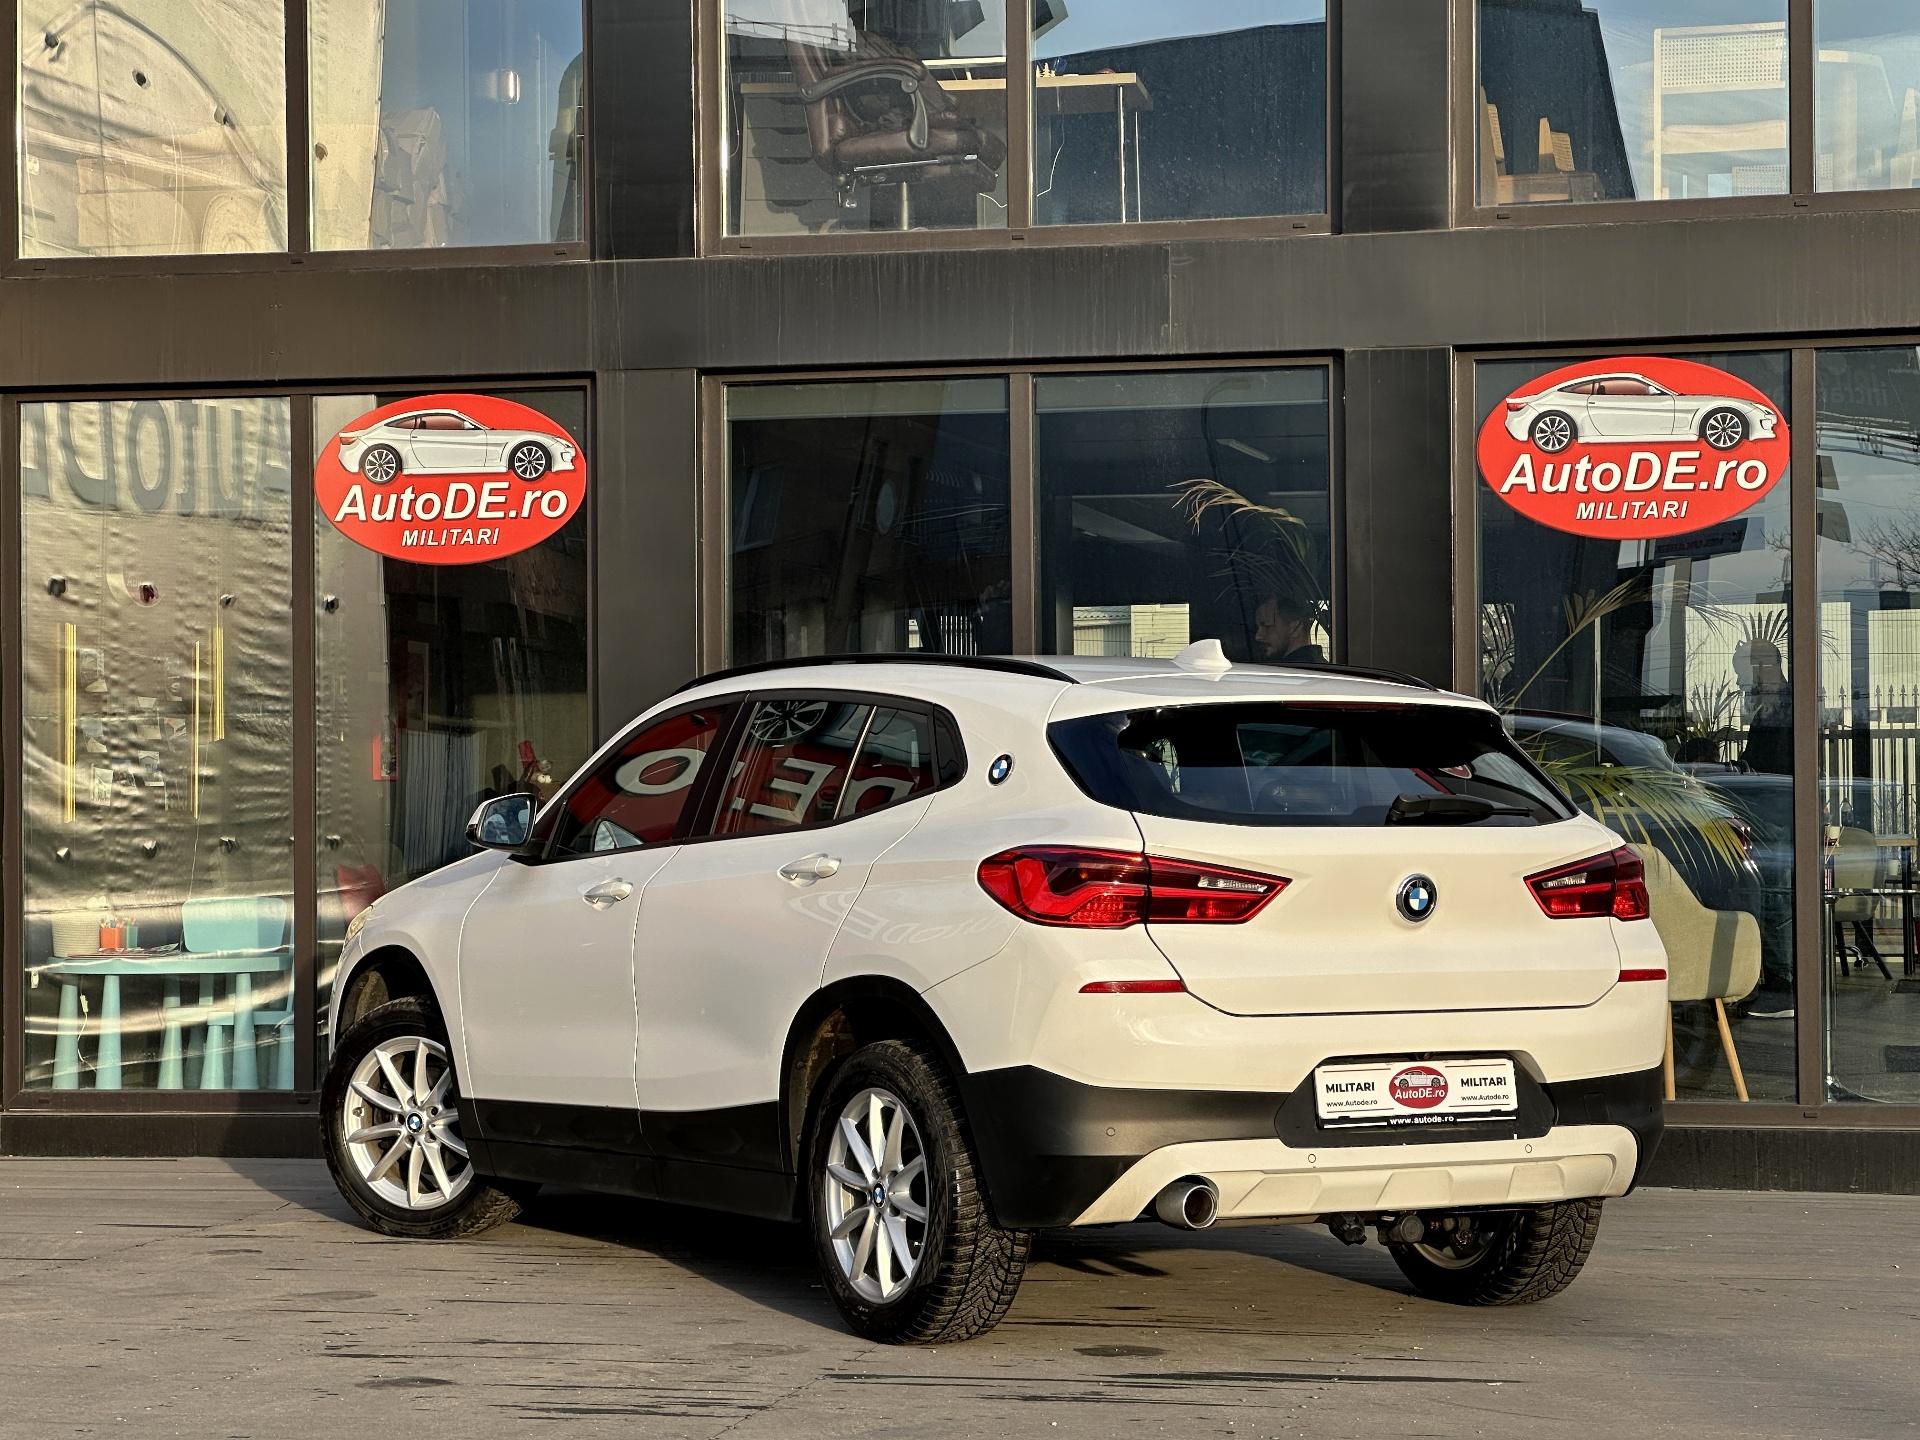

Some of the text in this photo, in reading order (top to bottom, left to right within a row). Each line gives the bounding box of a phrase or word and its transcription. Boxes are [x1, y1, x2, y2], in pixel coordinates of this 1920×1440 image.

[1499, 450, 1768, 495] AutoDE.ro
[333, 481, 569, 523] AutoDE.ro
[1575, 500, 1689, 520] MILITARI
[401, 528, 500, 547] MILITARI
[1325, 1082, 1375, 1093] MILITARI
[1461, 1077, 1507, 1088] MILITARI
[1394, 1088, 1446, 1099] AutoDE.ro
[1461, 1094, 1509, 1102] www.Autode.ro
[1326, 1100, 1378, 1108] www.Autode.ro
[1389, 1115, 1455, 1125] www.autode.ro
